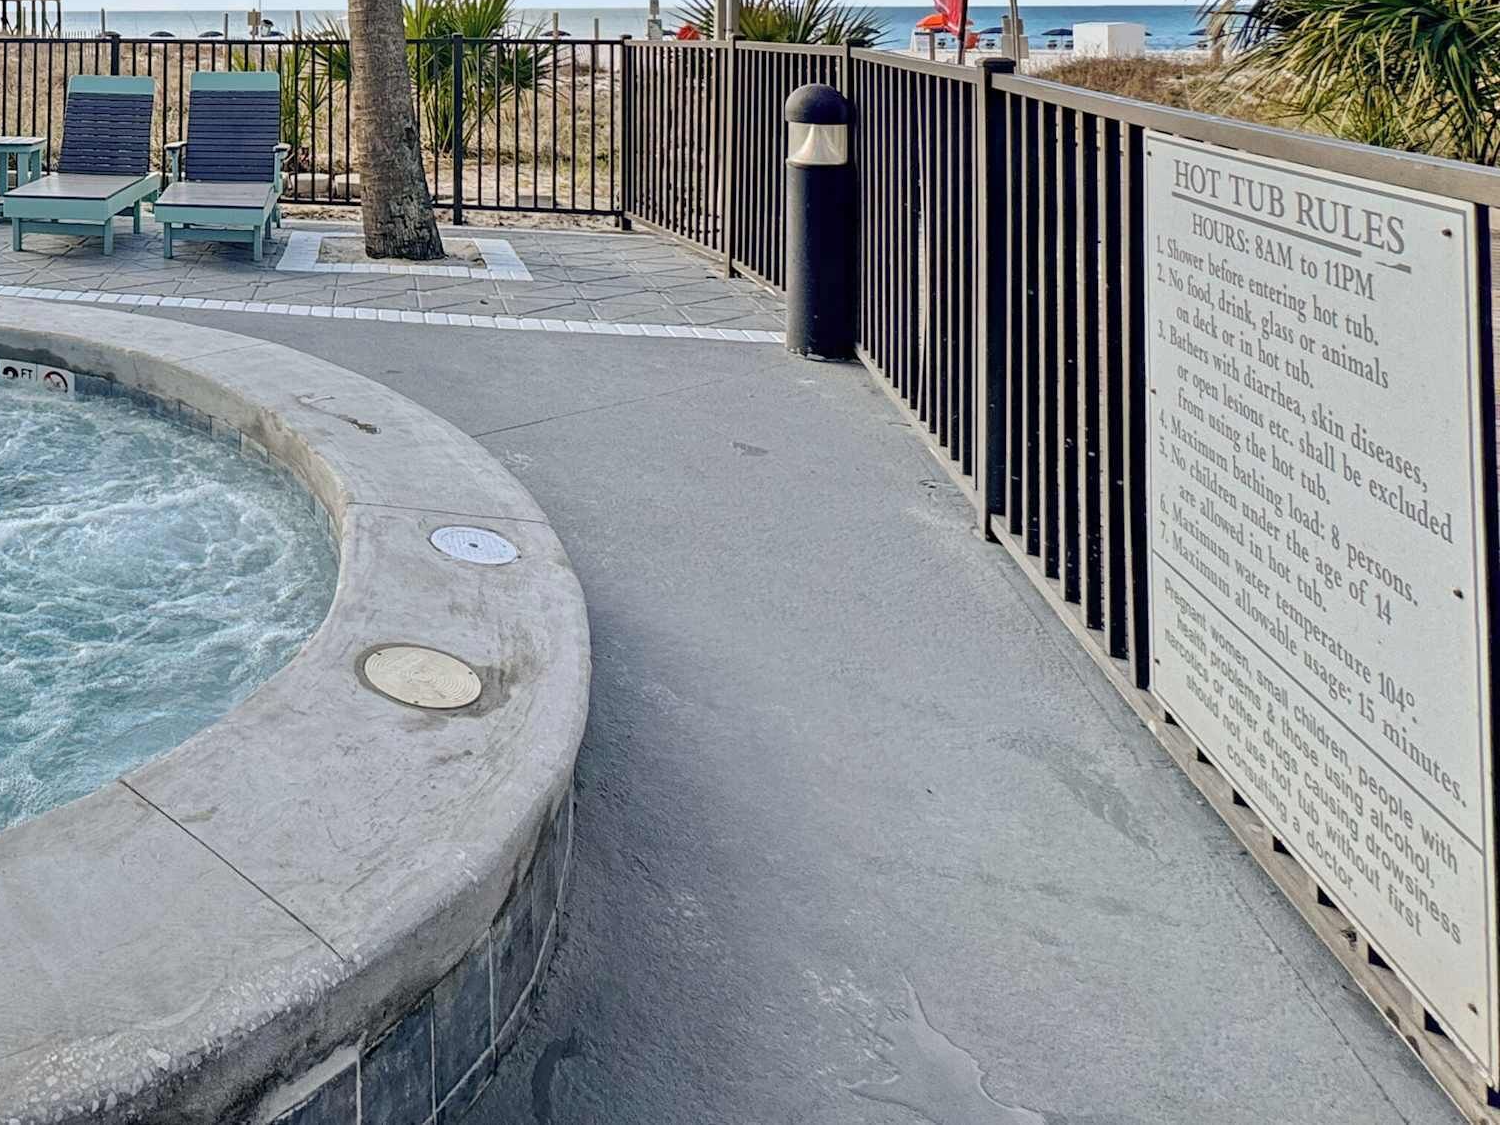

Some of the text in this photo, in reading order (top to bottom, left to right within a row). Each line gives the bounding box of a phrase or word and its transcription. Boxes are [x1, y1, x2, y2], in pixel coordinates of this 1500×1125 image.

[1167, 237, 1204, 272] Shower
[1207, 252, 1245, 289] before
[1248, 278, 1307, 323] entering
[1312, 293, 1338, 329] hot
[1344, 313, 1379, 347] tub.
[1173, 159, 1405, 255] HOT TUB RULES
[1192, 212, 1375, 302] HOURS: 8AM to 11PM
[1157, 262, 1389, 390] 2. No food, drink, glass or animals
[1157, 318, 1428, 494] 3. Bathers with diarrhea, skin diseases,
[1176, 306, 1314, 390] on deck or in hot tub.
[1159, 408, 1418, 607] 4. Maximum bathing load: 8 persons.
[1159, 435, 1392, 626] 5. No children under the age of 14
[1176, 364, 1454, 545] or open lesions etc. shall be excluded
[1178, 386, 1331, 506] from using the hot tub.
[1159, 493, 1170, 516] 6.
[1172, 501, 1230, 568] Maximum
[1234, 558, 1271, 600] water
[1275, 591, 1372, 685] temperature
[1179, 484, 1327, 613] are allowed in hot tub.
[1160, 519, 1467, 808] 7. Maximum allowable usage: 15 minutes.
[1164, 576, 1207, 632] Pregnant
[1256, 669, 1289, 711] small
[1358, 765, 1414, 831] people
[1420, 824, 1458, 875] with
[1176, 612, 1207, 657] health
[1210, 650, 1262, 712] problems
[1280, 715, 1319, 768] those
[1324, 762, 1364, 818] using
[1164, 627, 1462, 945] narcotics or other drugs causing drowsiness
[1186, 674, 1422, 937] should not use hot tub without first
[1227, 743, 1287, 819] consulting
[1306, 830, 1358, 897] doctor.
